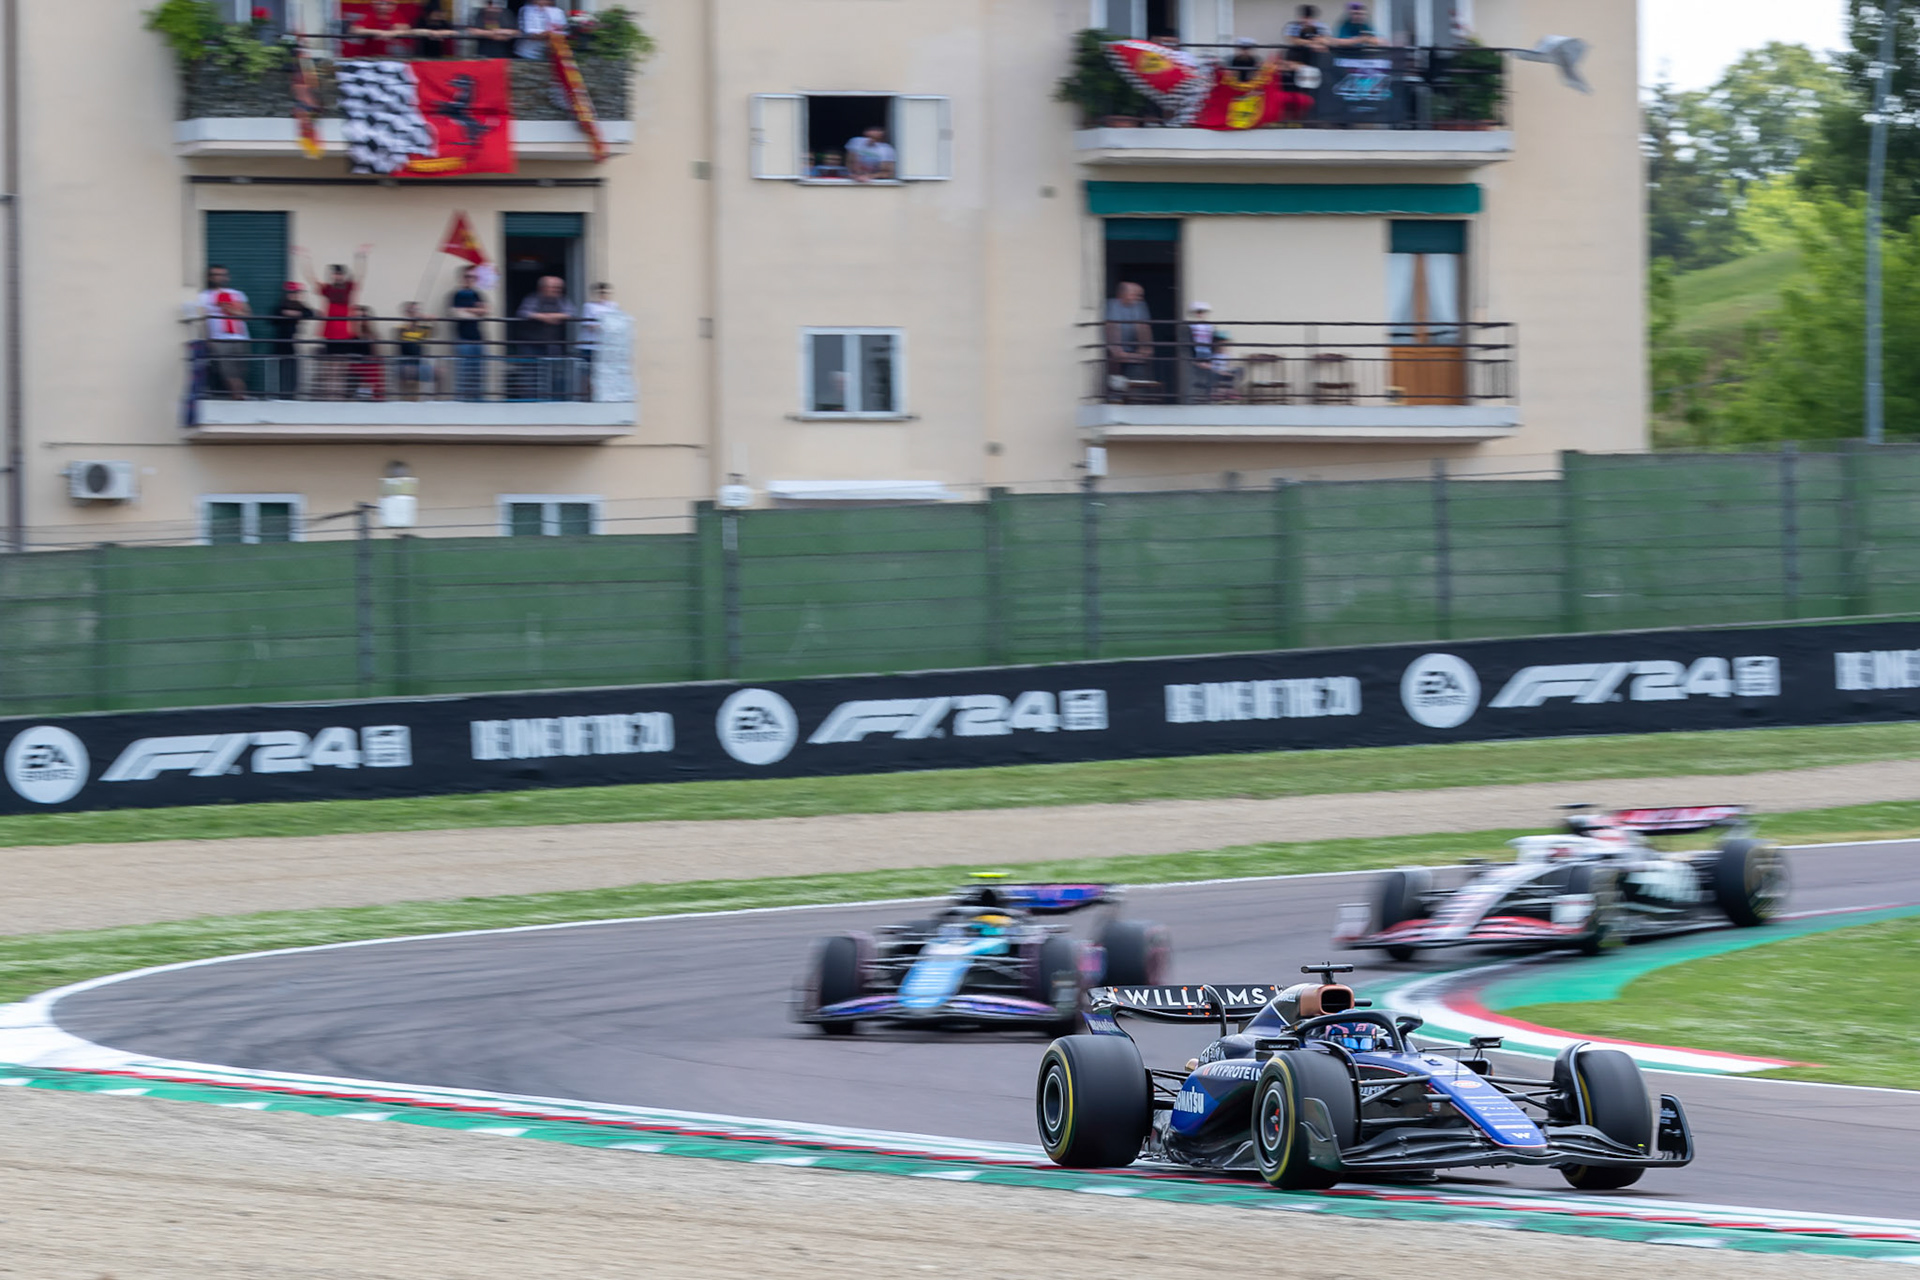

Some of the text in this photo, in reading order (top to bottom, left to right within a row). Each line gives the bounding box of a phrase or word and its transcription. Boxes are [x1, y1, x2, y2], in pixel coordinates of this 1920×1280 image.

[1629, 656, 1732, 701] 24
[951, 690, 1059, 736] 24
[250, 727, 360, 773] 24
